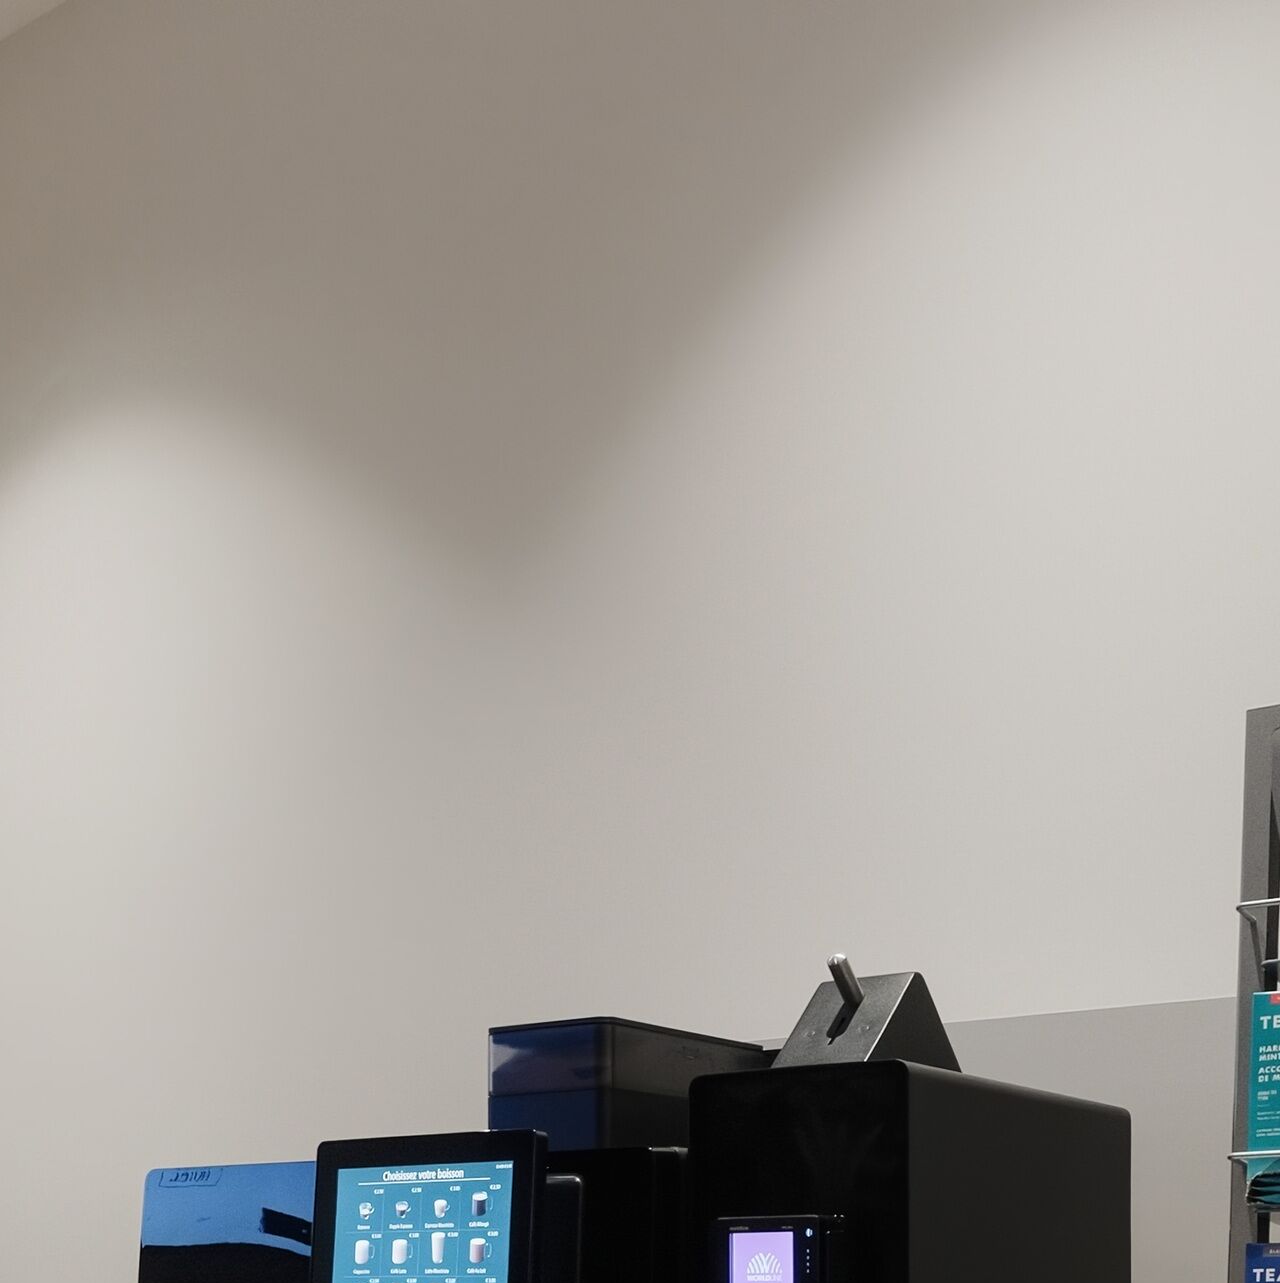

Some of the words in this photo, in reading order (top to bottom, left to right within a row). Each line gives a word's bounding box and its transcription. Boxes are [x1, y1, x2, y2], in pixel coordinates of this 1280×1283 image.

[1258, 1074, 1269, 1083] DE
[382, 1170, 418, 1181] Choisissez
[418, 1169, 437, 1180] votre
[437, 1168, 465, 1179] boisson
